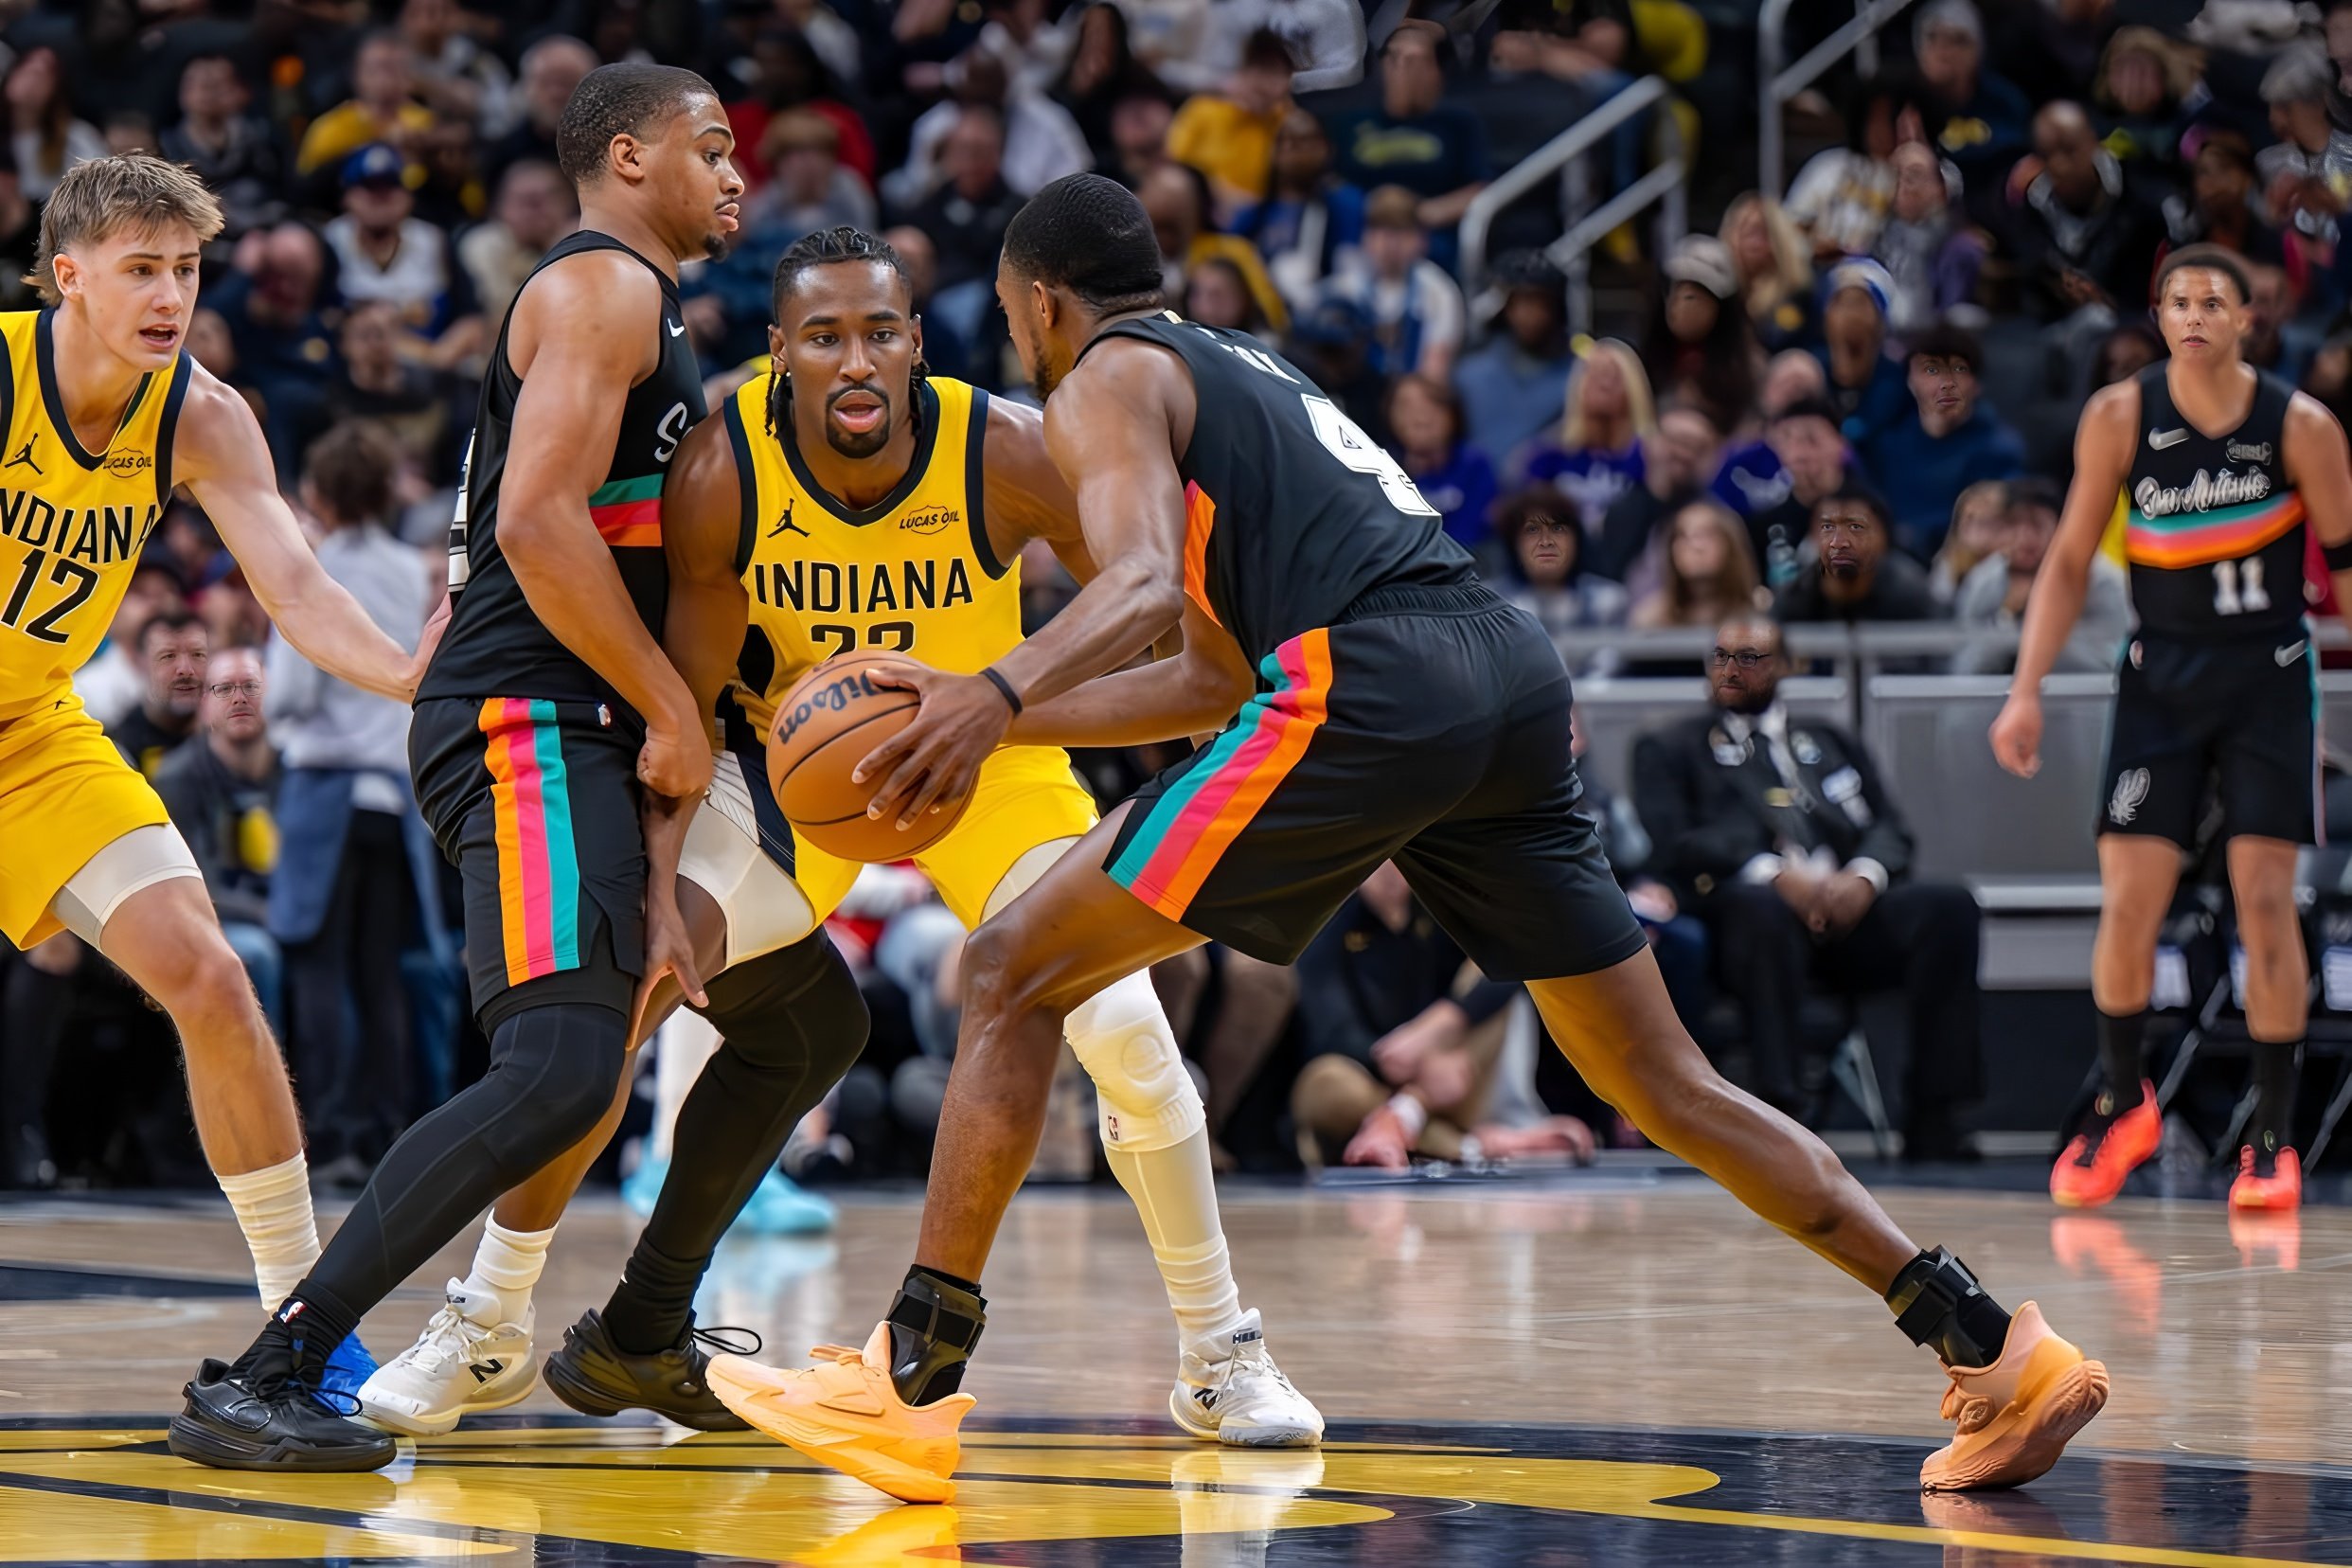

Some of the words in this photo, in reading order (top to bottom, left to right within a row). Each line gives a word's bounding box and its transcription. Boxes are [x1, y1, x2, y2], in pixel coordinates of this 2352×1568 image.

[1300, 393, 1443, 517] 4
[899, 513, 938, 529] LUCAS
[940, 510, 960, 525] OIL
[0, 547, 100, 645] 12
[754, 557, 973, 615] INDIANA
[2212, 555, 2272, 616] 11
